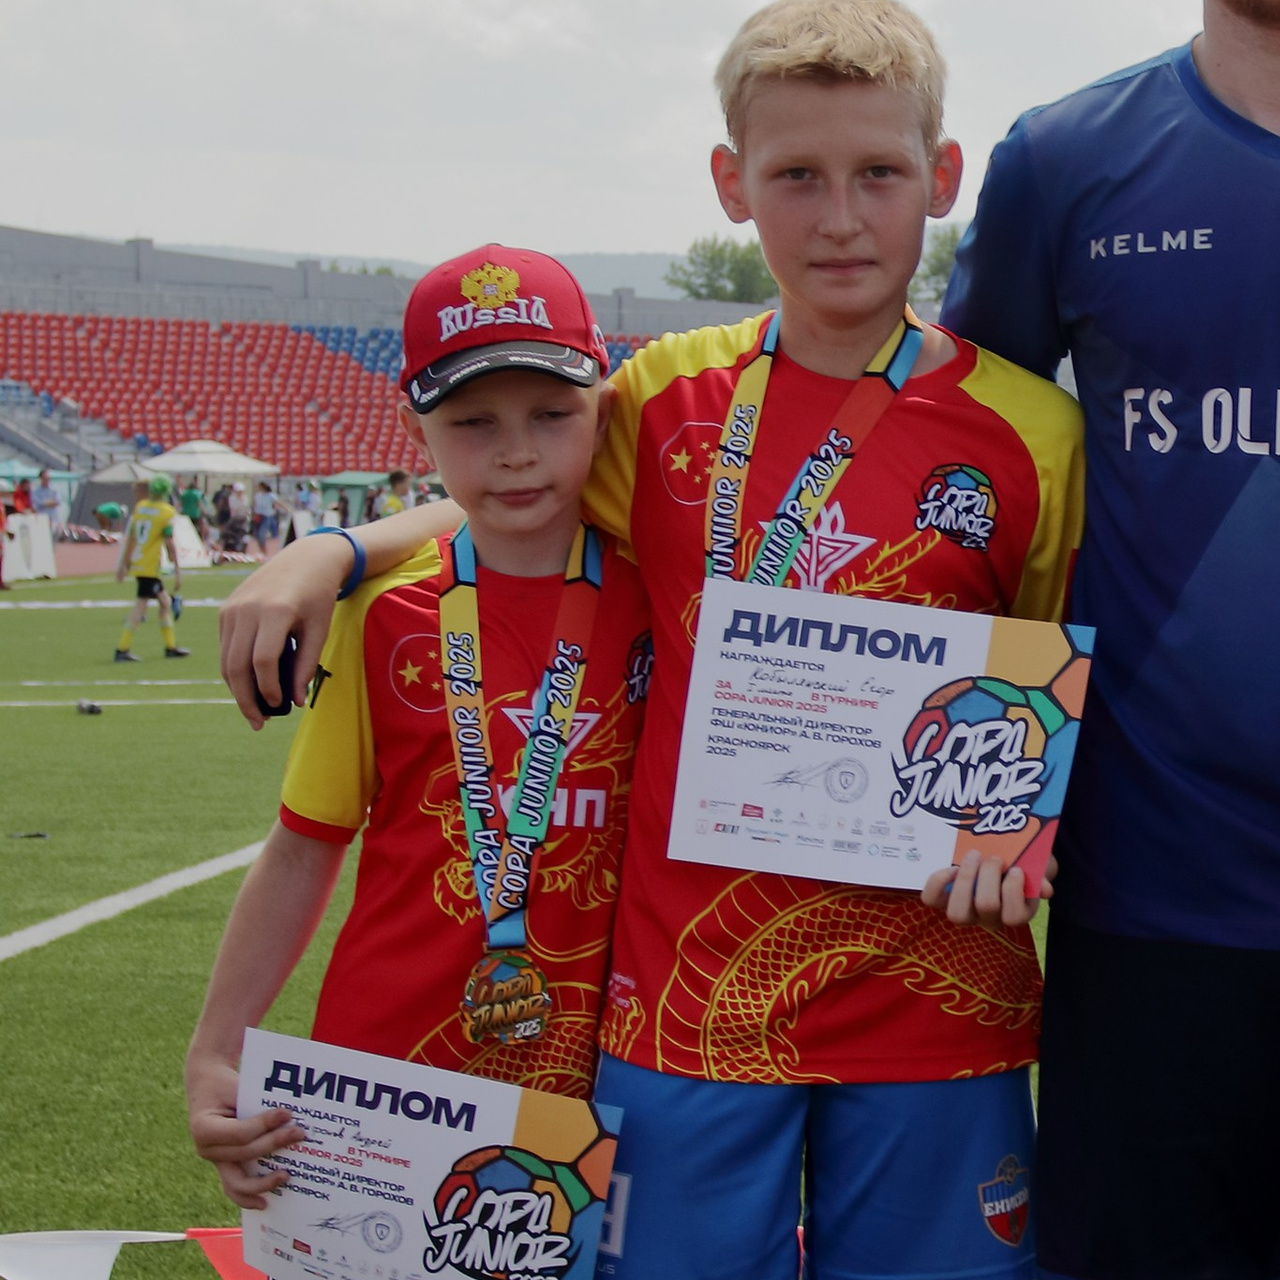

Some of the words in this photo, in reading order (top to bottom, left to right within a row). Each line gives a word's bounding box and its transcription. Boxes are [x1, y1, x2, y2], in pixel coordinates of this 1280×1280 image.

[1090, 228, 1214, 260] KELME
[437, 296, 553, 342] RUSSIA
[721, 404, 757, 469] 2025
[1123, 387, 1178, 455] FS
[800, 428, 853, 498] 2025
[926, 483, 988, 516] COPA
[916, 501, 994, 537] JUNIOR
[723, 609, 947, 666] ДИПЛОМ
[447, 631, 477, 697] 2025
[720, 650, 825, 672] НАГРАЖДАЕТСЯ
[716, 680, 732, 690] ЗА
[811, 693, 820, 701] В
[823, 694, 879, 709] ТУРНИРЕ
[714, 691, 747, 704] COPA
[748, 695, 793, 709] JUNIOR
[795, 701, 828, 713] 2025
[711, 718, 735, 729] ФШ
[737, 722, 797, 737] «ЮНИОР»
[826, 734, 882, 749] ГОРОХОВ
[712, 707, 804, 727] ГЕНЕРАЛЬНЫЙ
[805, 719, 873, 736] ДИРЕКТОР
[706, 745, 737, 757] 2025
[708, 735, 791, 753] КРАСНОЯРСК
[911, 721, 1026, 766] COPA
[497, 835, 537, 909] COPA
[546, 639, 582, 708] 2025
[891, 760, 1045, 816] JUNIOR
[973, 803, 1030, 833] 2025
[264, 1060, 477, 1133] ДИПЛОМ
[261, 1098, 360, 1128] НАГРАЖДАЕТСЯ
[334, 1154, 363, 1167] 2025
[348, 1146, 356, 1155] В
[358, 1148, 412, 1168] ТУРНИРЕ
[342, 1172, 405, 1192] ДИРЕКТОР
[362, 1187, 414, 1206] ГОРОХОВ
[442, 1187, 553, 1233] COPA
[424, 1222, 571, 1272] JUNIOR
